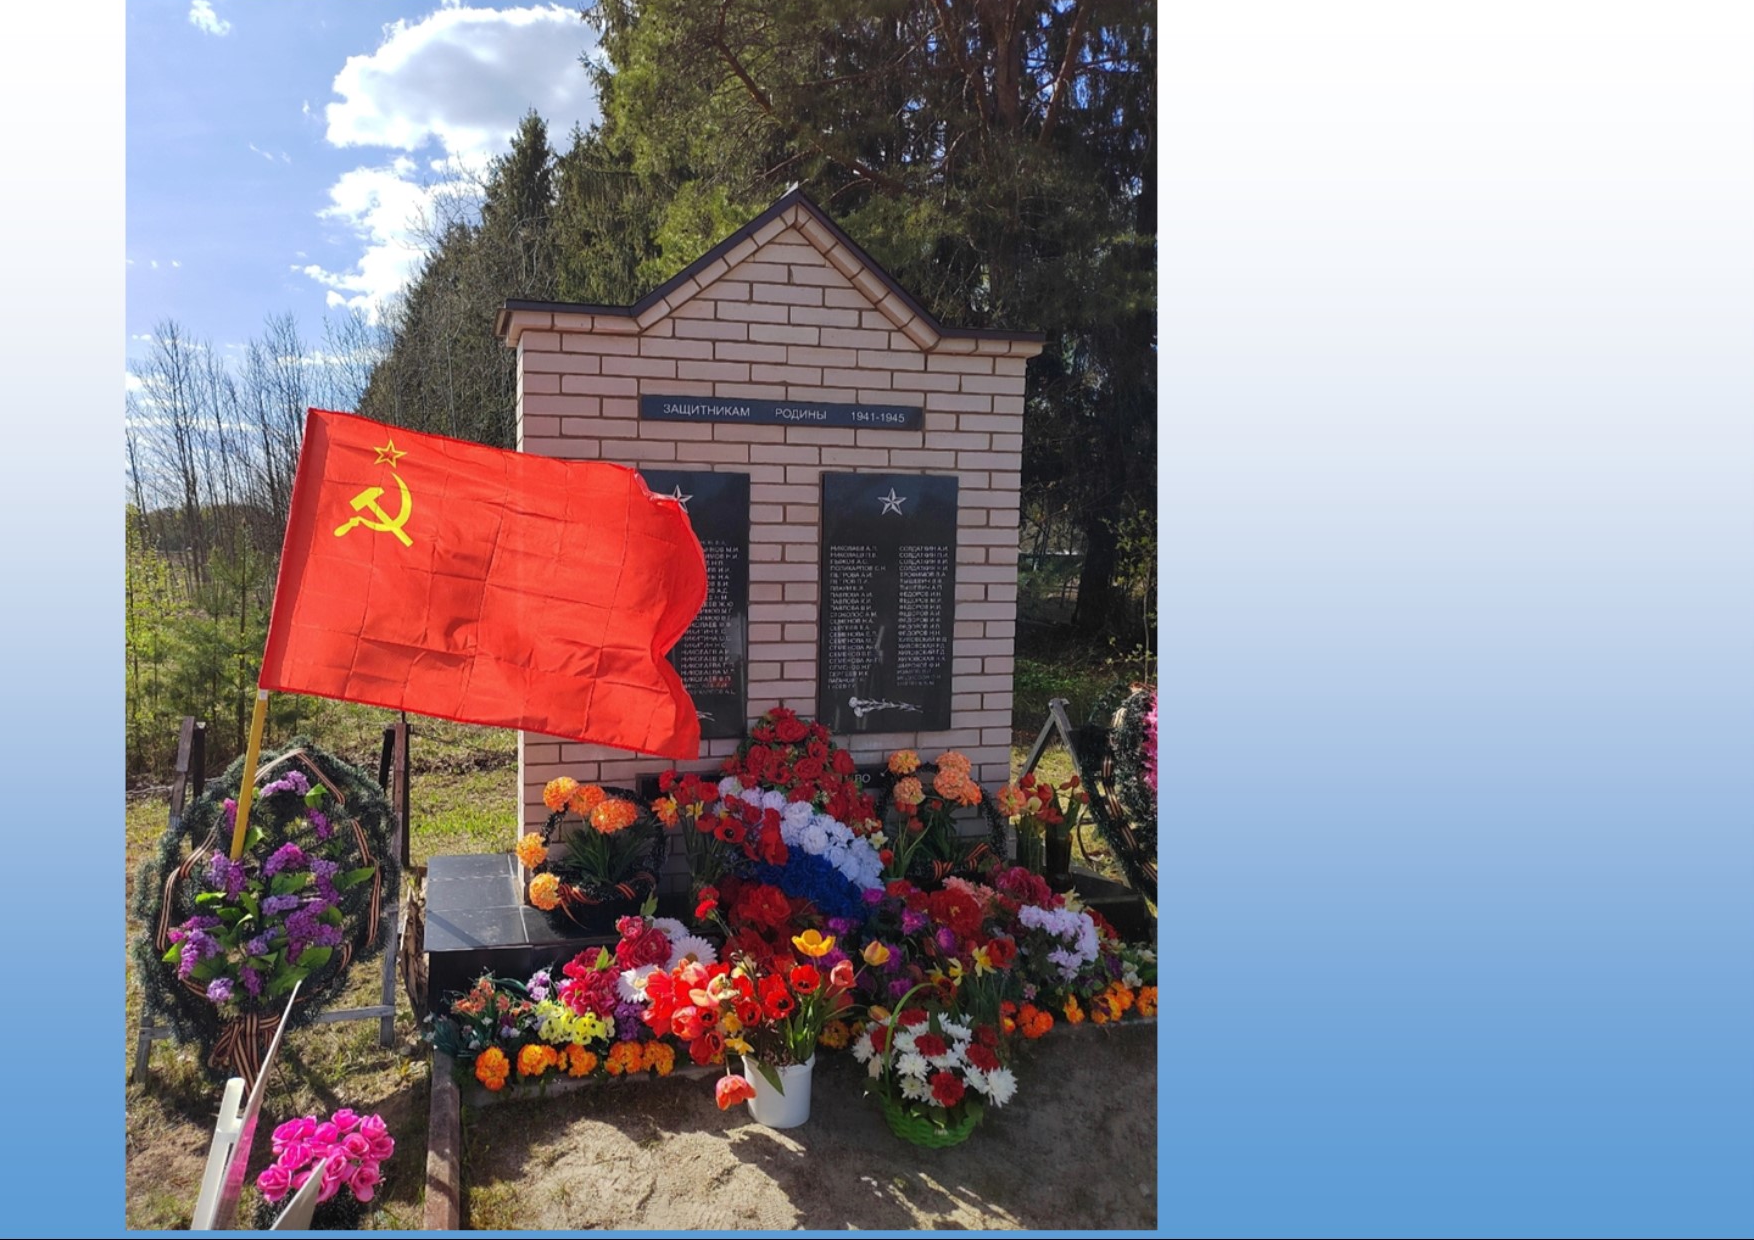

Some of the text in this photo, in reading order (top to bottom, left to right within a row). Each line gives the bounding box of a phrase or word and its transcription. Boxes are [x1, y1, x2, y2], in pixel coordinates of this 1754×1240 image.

[663, 403, 905, 423] ЗАЩИТНИКАМ РОДИНЫ 1941-1945
